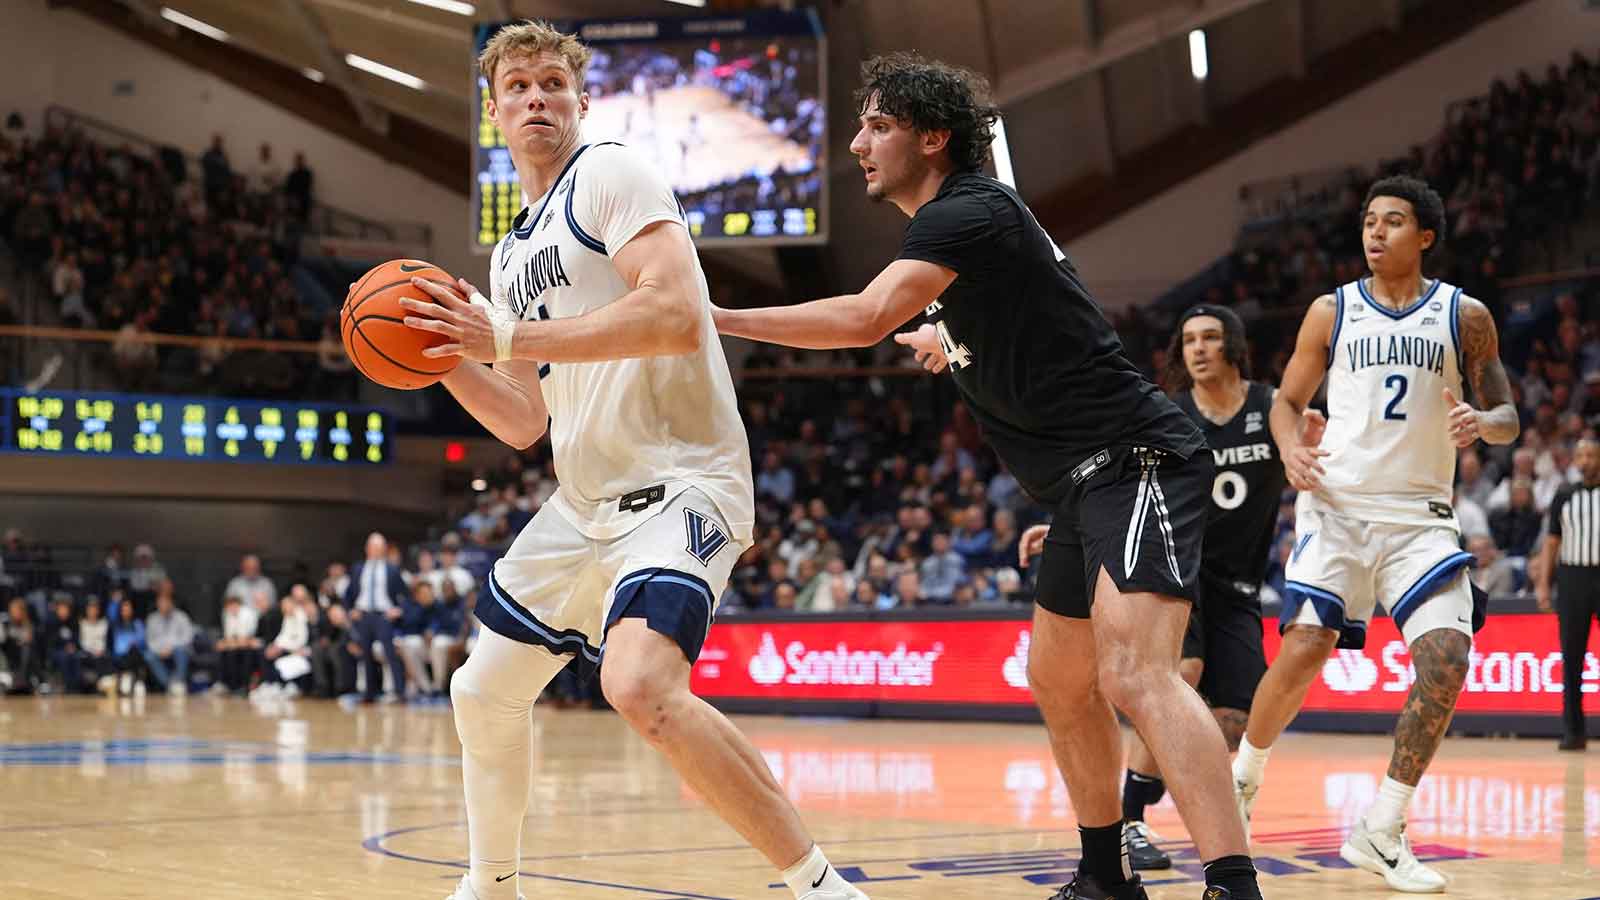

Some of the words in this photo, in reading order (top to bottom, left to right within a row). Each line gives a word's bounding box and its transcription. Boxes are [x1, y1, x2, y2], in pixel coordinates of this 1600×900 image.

[1348, 335, 1444, 377] VILLANOVA
[1384, 374, 1408, 420] 2
[1212, 443, 1272, 466] VIER
[1211, 471, 1248, 510] 0
[785, 641, 934, 685] Santander
